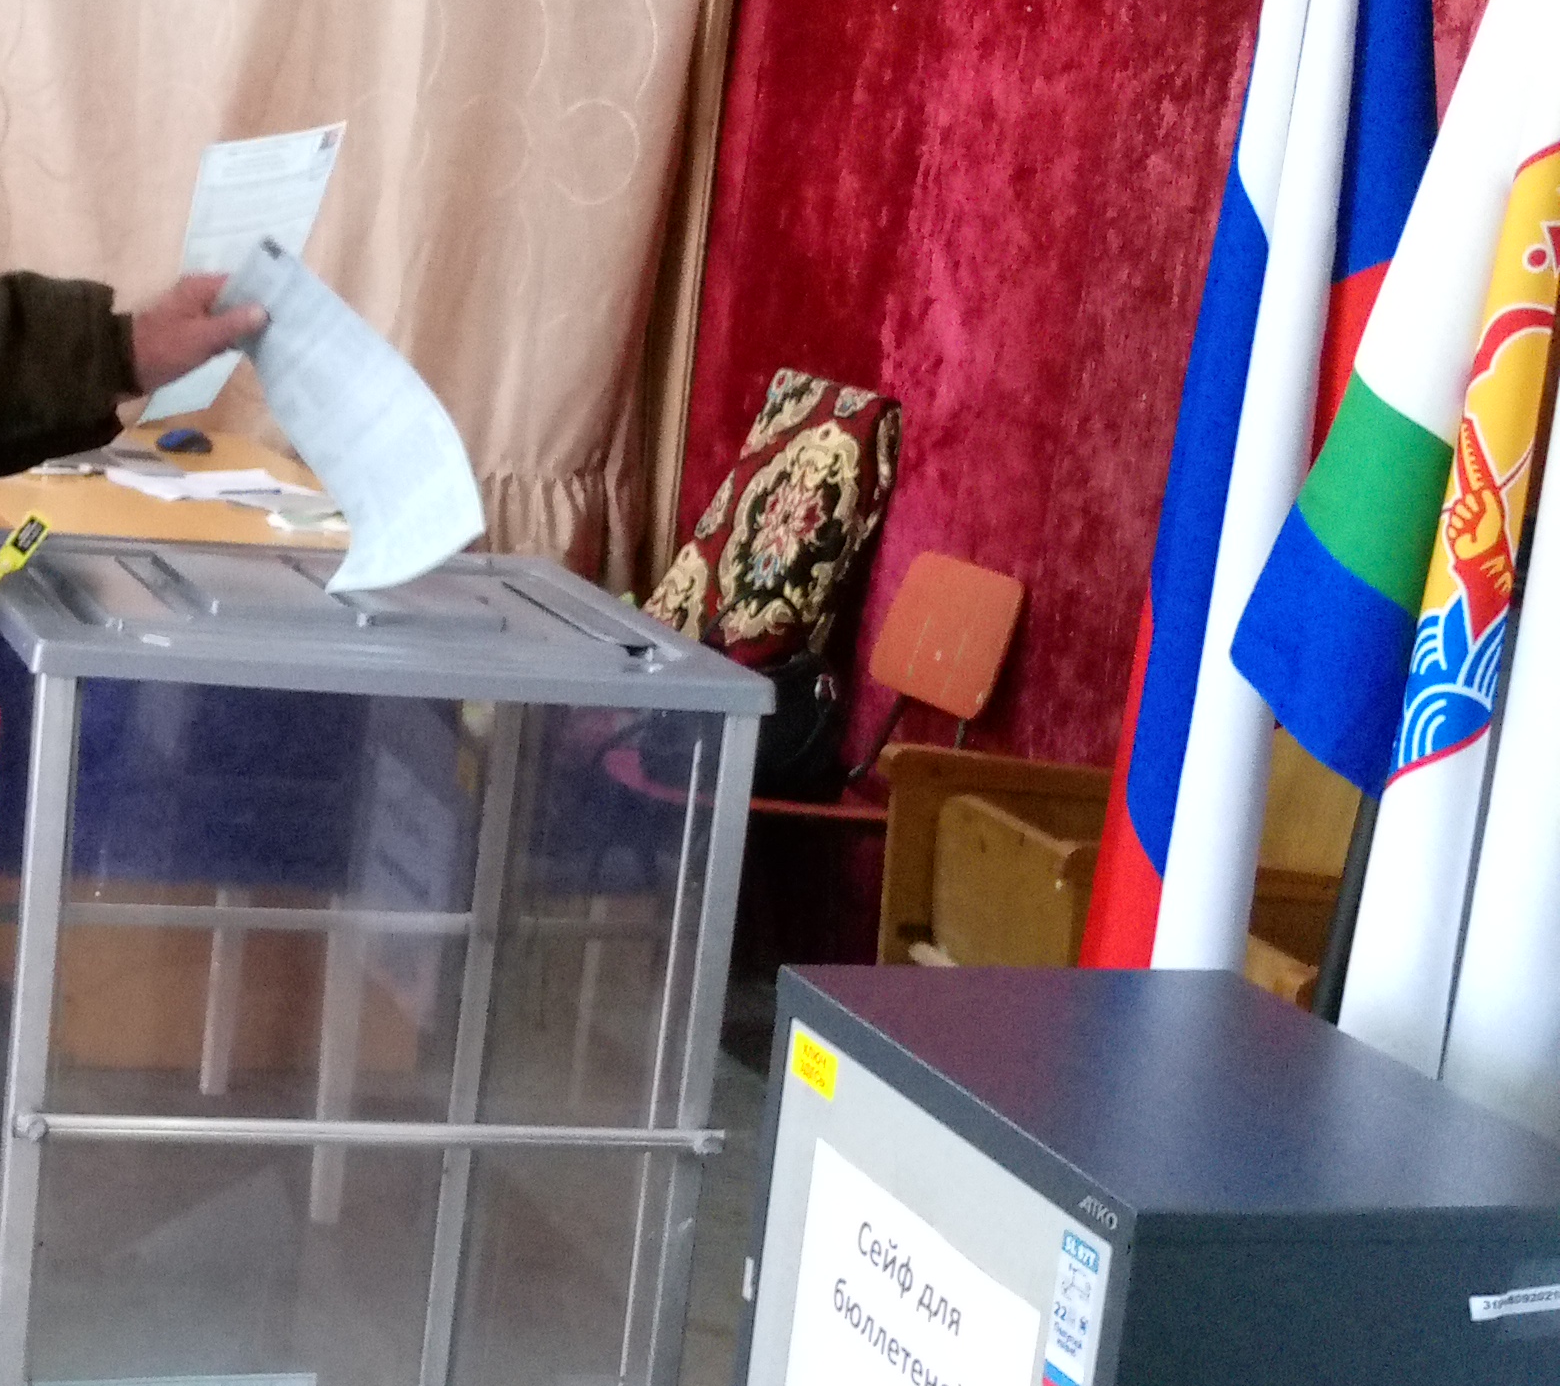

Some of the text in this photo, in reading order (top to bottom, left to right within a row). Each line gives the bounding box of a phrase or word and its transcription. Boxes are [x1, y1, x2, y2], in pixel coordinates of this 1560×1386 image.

[1078, 1195, 1119, 1231] AIKO
[857, 1220, 962, 1337] Сейф для
